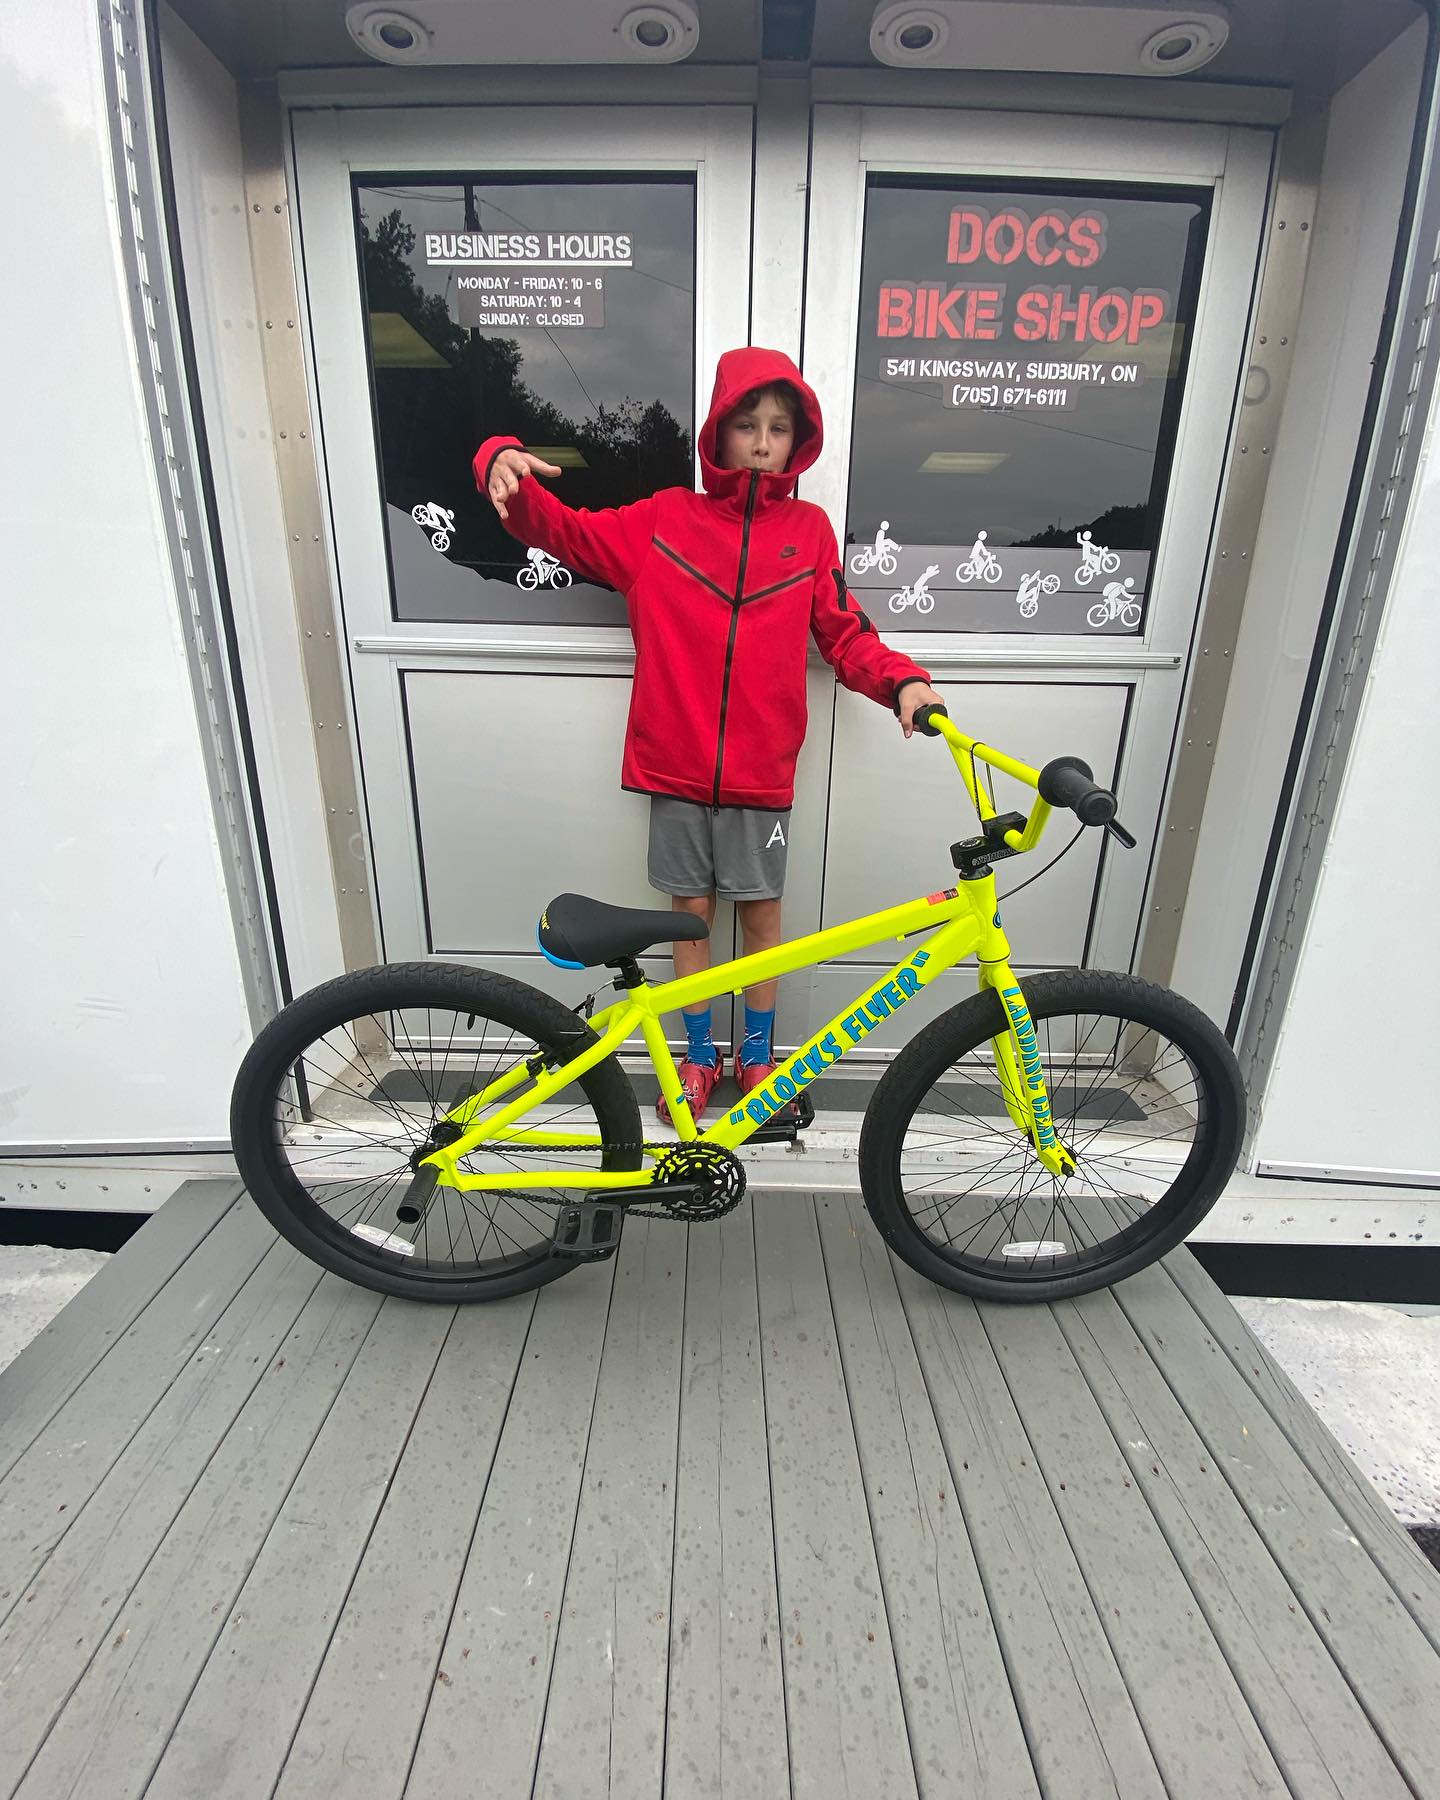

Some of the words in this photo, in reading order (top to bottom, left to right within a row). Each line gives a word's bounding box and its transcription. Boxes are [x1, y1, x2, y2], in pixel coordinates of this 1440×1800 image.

[425, 234, 540, 258] BUSINESS
[547, 235, 631, 259] HOURS
[947, 212, 1101, 267] DOCS
[458, 277, 510, 290] MONDAY
[522, 277, 568, 290] FRIDAY:
[571, 277, 583, 290] 10
[594, 277, 603, 290] 6
[480, 295, 547, 308] SATURDAY:
[549, 296, 562, 308] 10
[573, 296, 581, 308] 4
[479, 313, 529, 325] SUNDAY:
[536, 313, 584, 326] CLOSED
[876, 288, 999, 341] BIKE
[1013, 292, 1164, 345] SHOP
[887, 359, 915, 377] 541
[919, 360, 1021, 382] KINGSWAY,
[1026, 362, 1105, 384] SUDBURY,
[1111, 365, 1137, 382] ON
[952, 384, 998, 406] (705)
[1002, 387, 1067, 406] 671-6111
[765, 819, 786, 848] A
